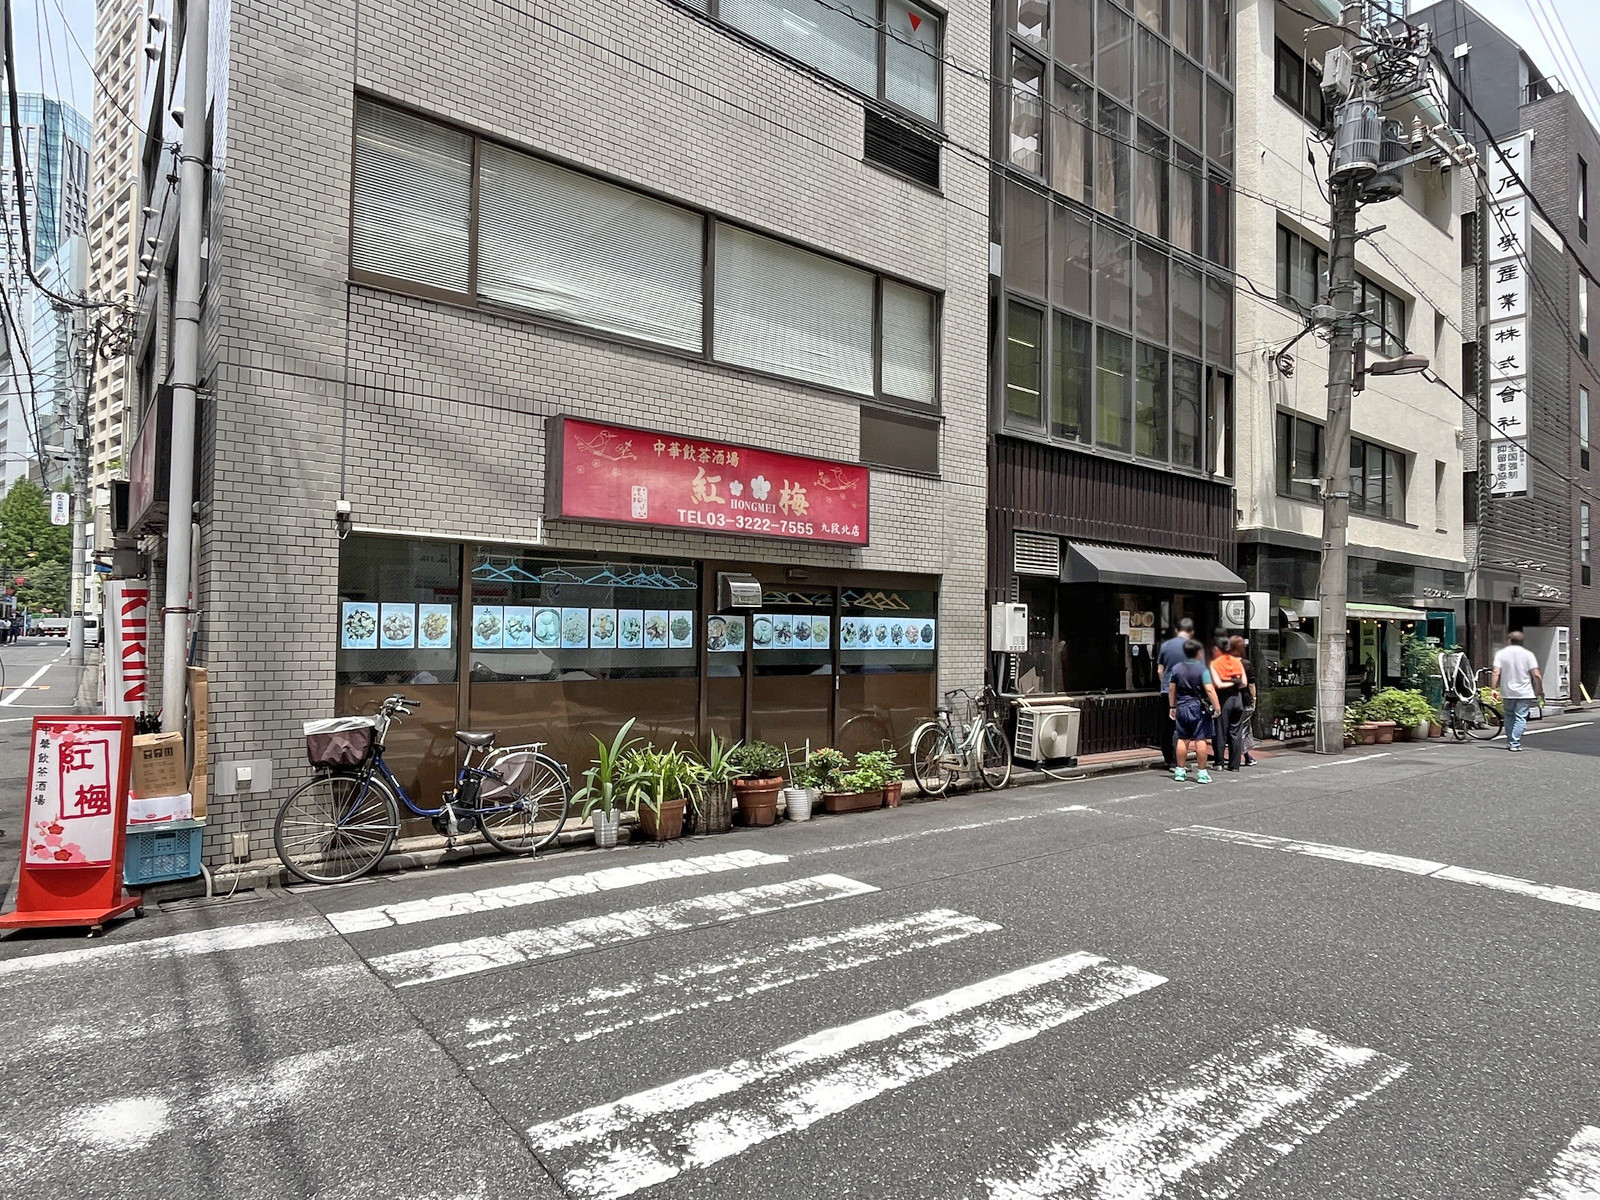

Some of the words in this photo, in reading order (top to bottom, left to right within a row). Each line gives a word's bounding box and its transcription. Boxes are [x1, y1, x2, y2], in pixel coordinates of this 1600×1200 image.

[730, 498, 777, 515] HONGMEI
[820, 522, 861, 537] 九段北店
[121, 588, 149, 702] KIRIN
